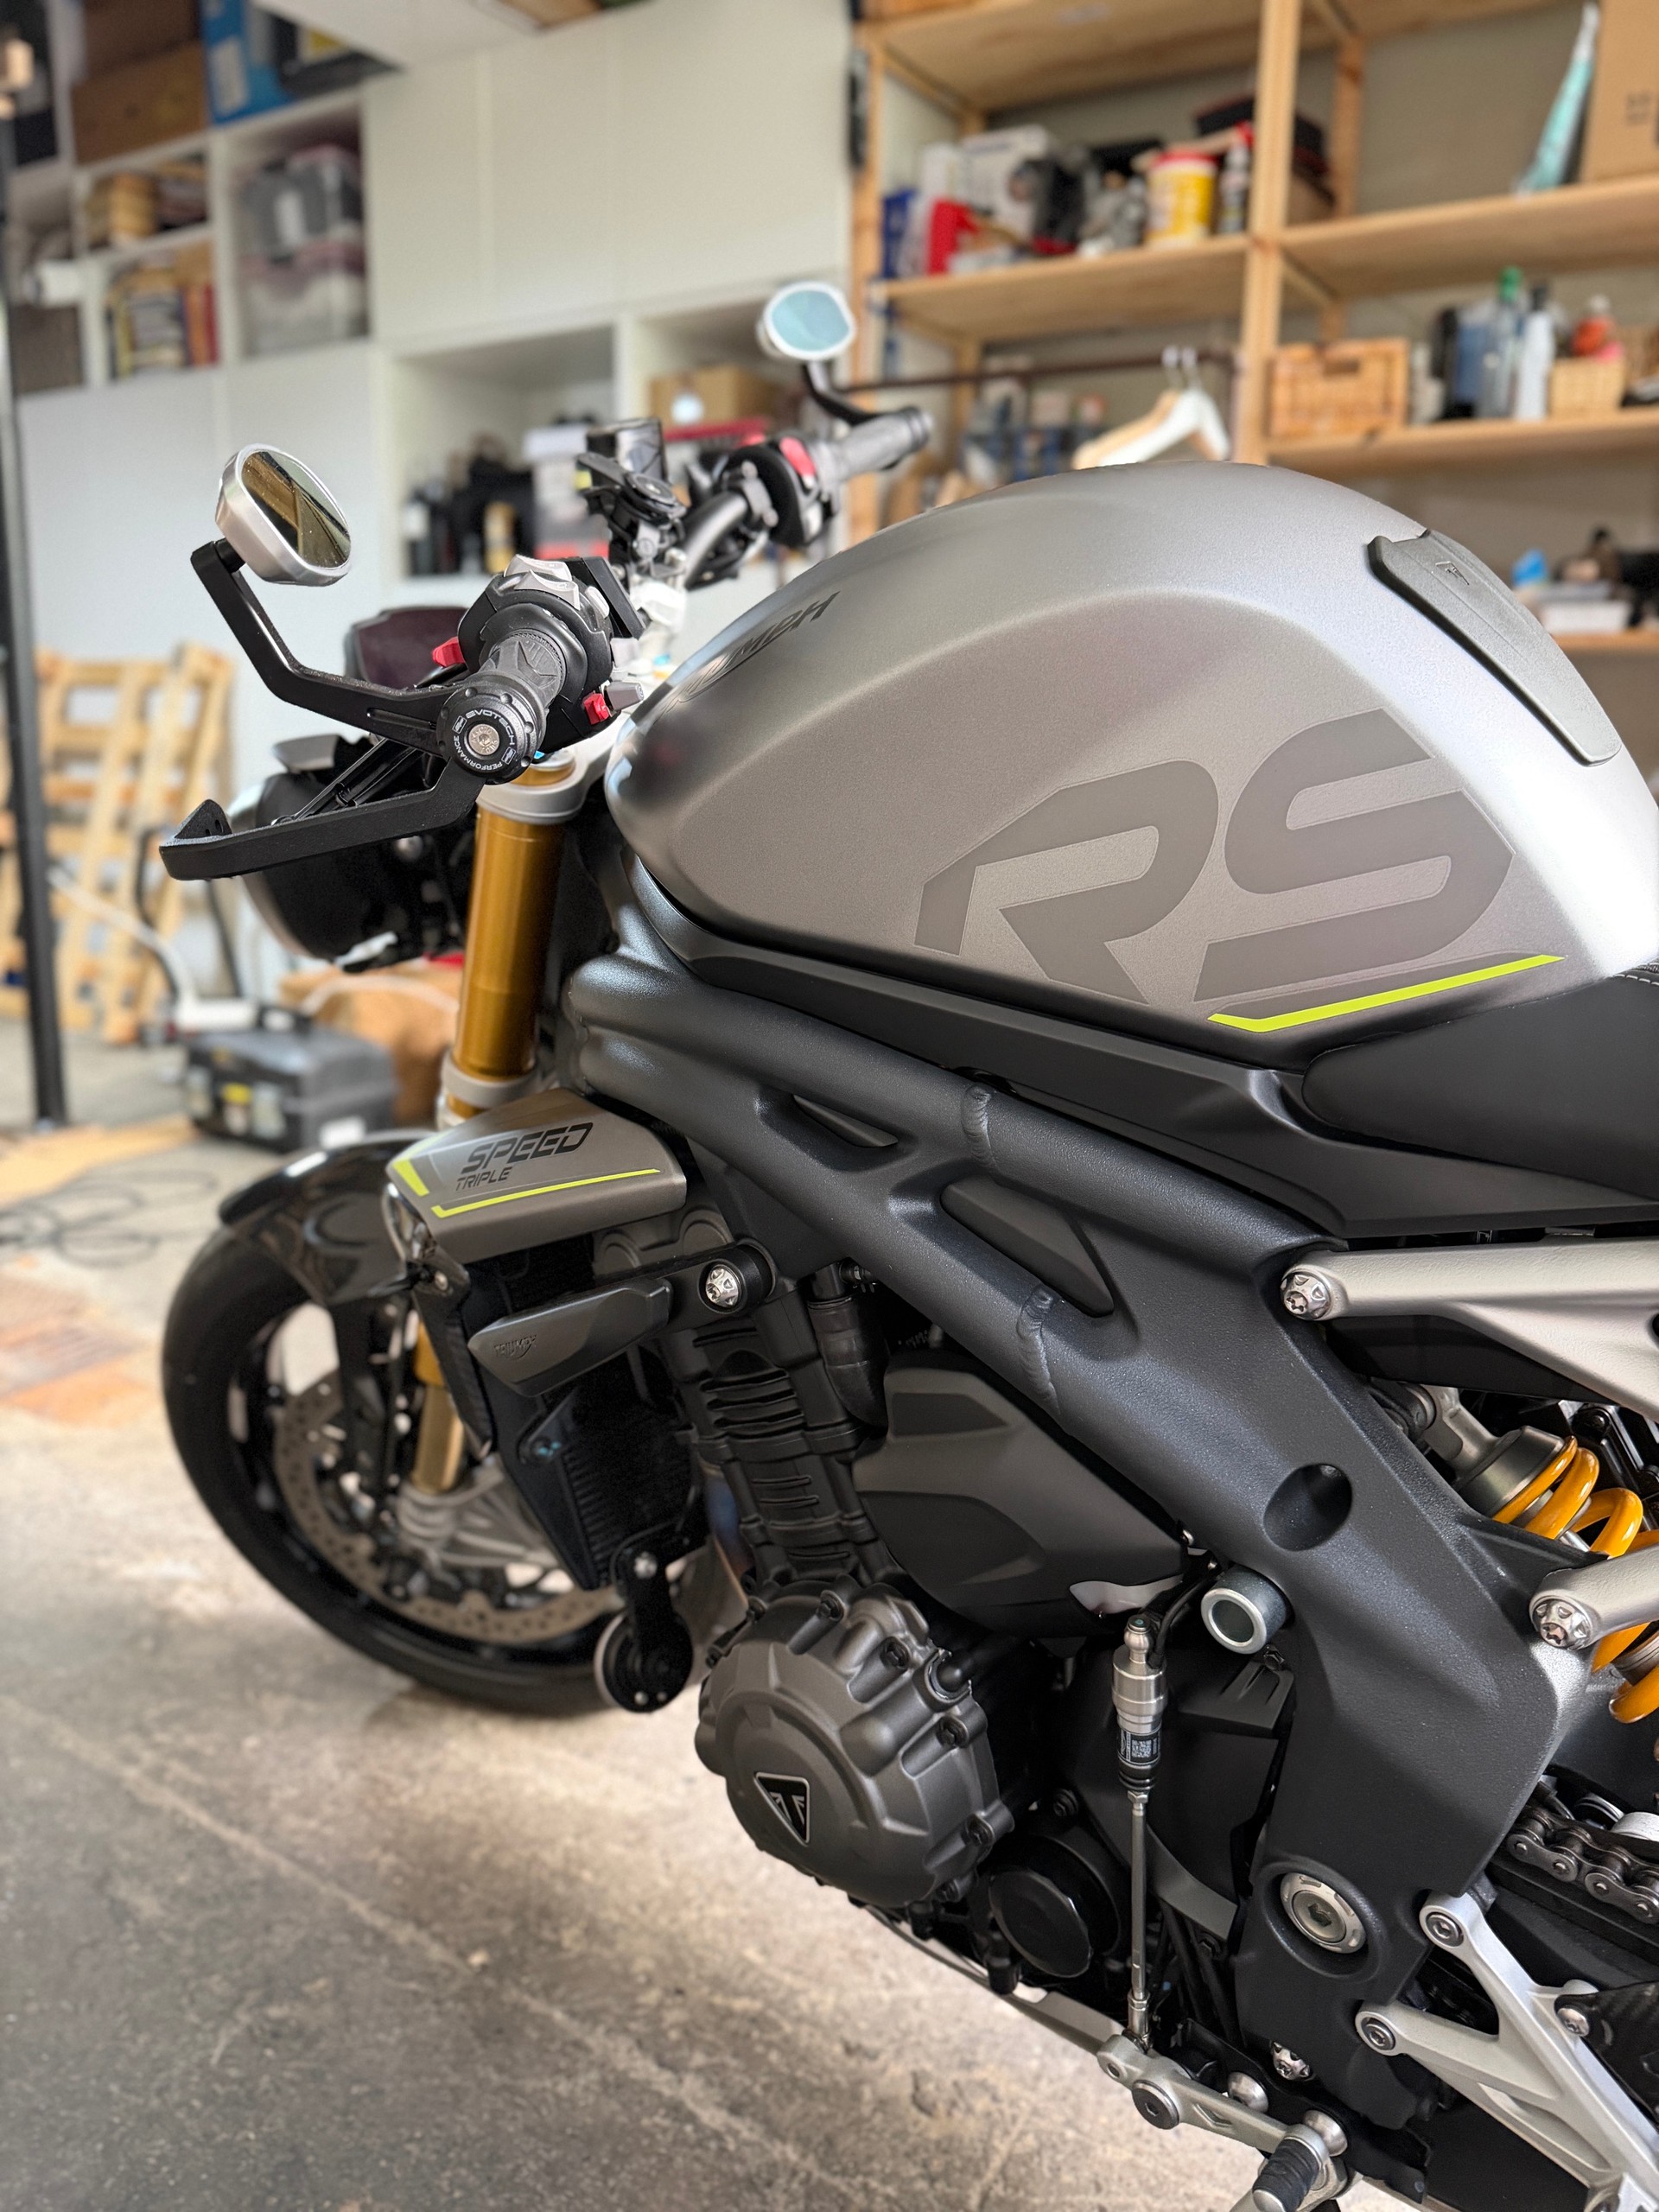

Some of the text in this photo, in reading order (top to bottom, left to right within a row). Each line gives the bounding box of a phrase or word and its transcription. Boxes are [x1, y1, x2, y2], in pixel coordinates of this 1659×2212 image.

[453, 709, 516, 771] EVOTECH PERFORMANCE
[913, 707, 1516, 1005] RS
[461, 1122, 594, 1175] SPEED
[455, 1166, 512, 1191] TRIPLE
